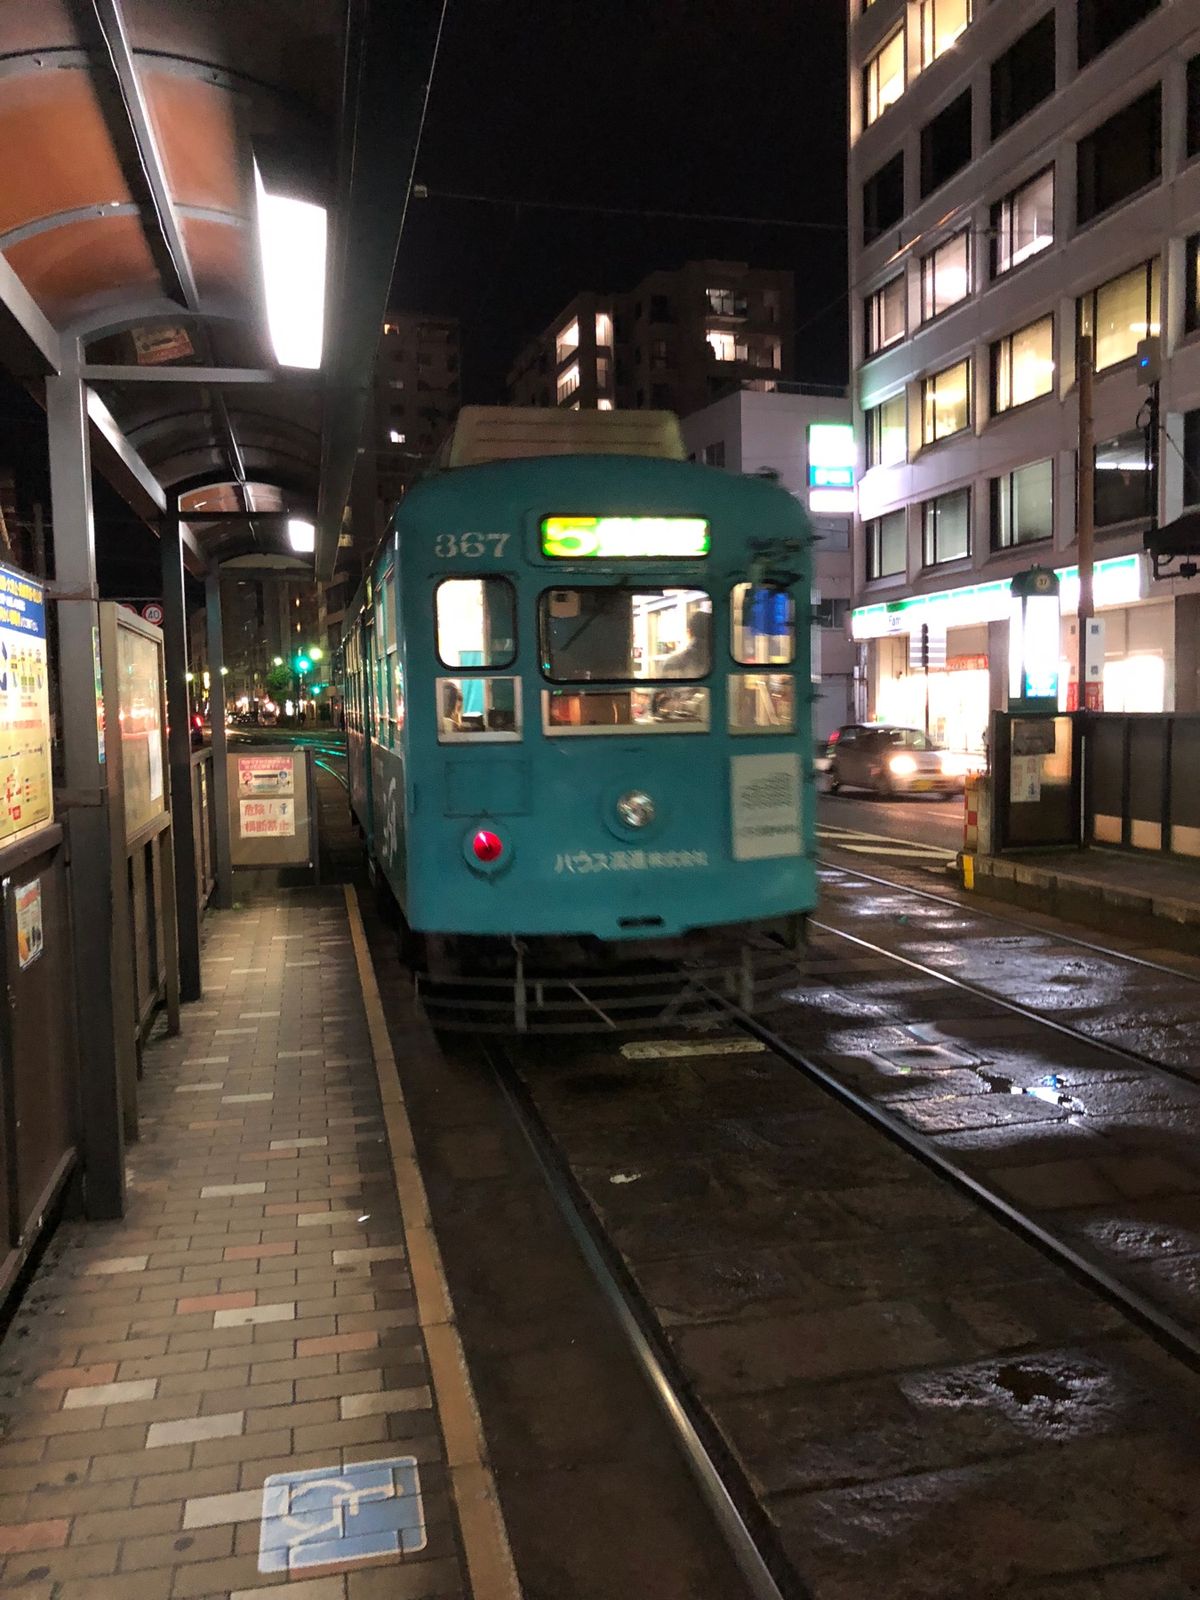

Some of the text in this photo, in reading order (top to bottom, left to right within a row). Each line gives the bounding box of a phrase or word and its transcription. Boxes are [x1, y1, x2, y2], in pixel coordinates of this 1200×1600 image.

[435, 532, 511, 558] 367
[544, 518, 598, 556] 5
[149, 610, 159, 619] 40
